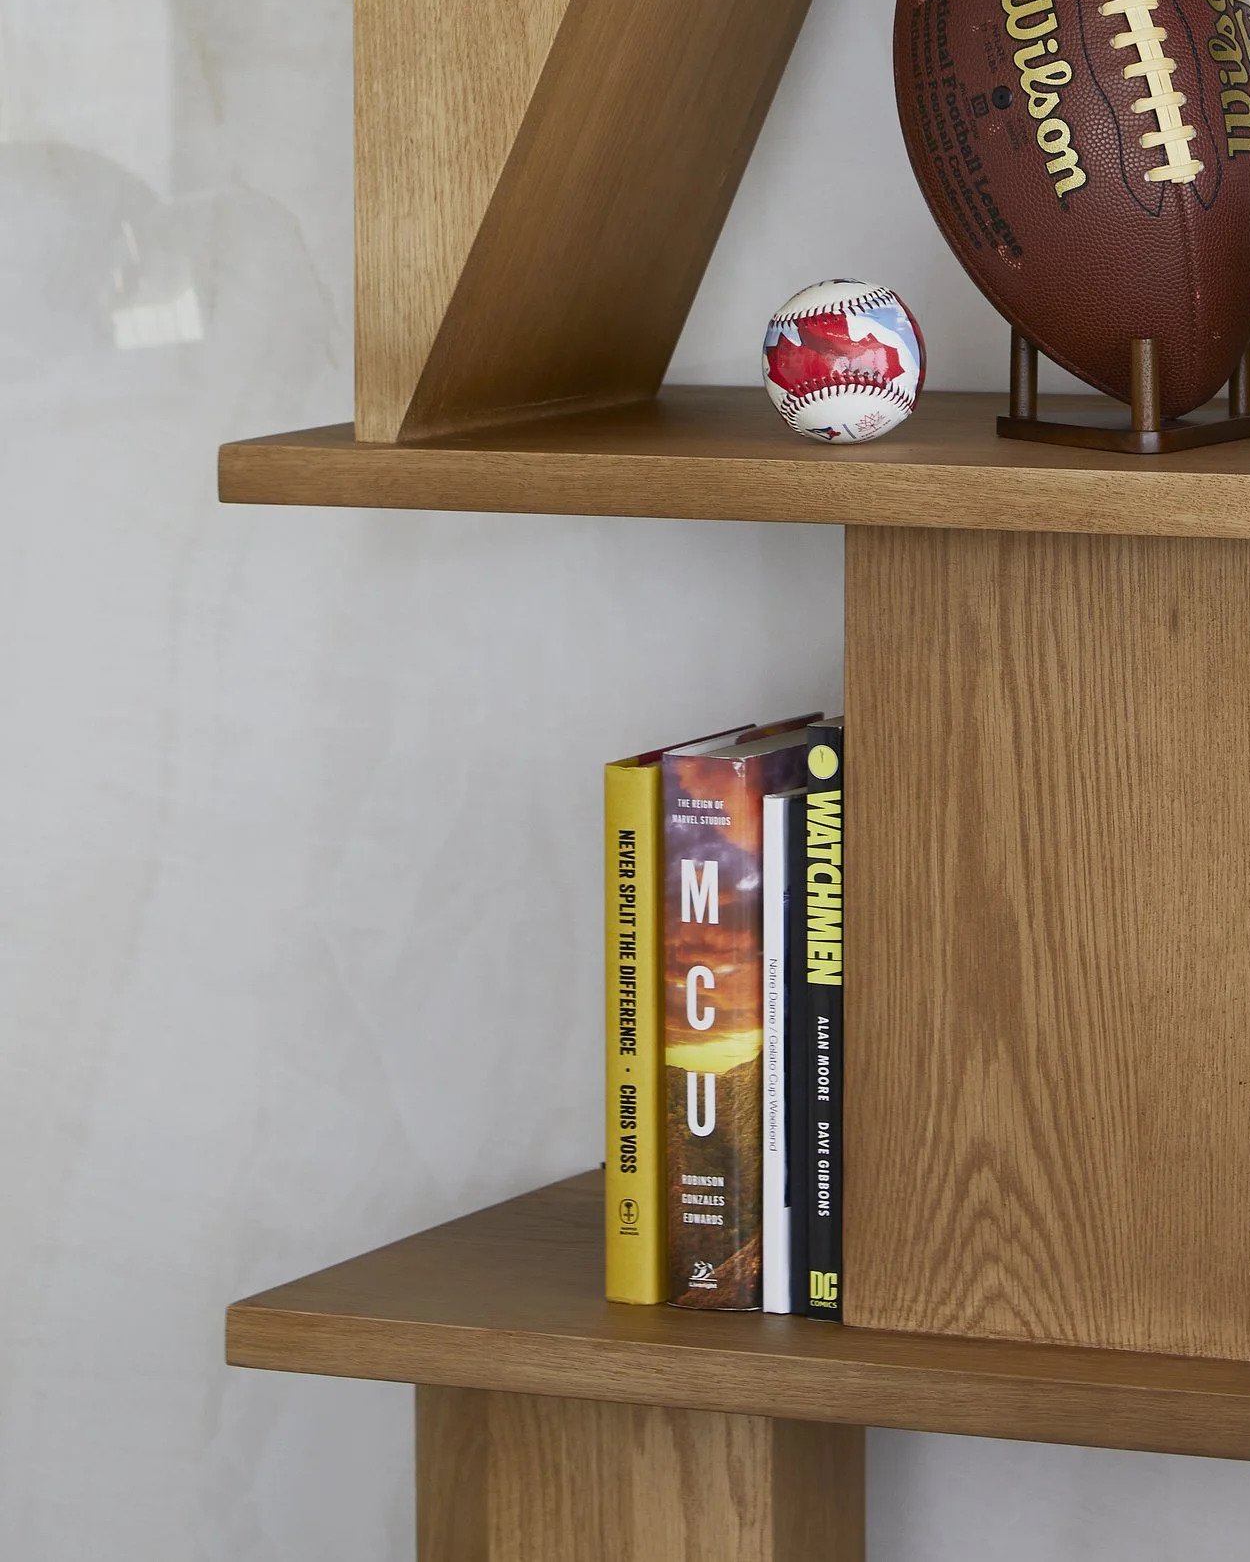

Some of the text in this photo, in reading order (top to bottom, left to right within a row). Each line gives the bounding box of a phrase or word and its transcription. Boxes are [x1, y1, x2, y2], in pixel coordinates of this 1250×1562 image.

[911, 5, 982, 249] National Football Conference
[929, 77, 954, 152] Football
[950, 155, 1000, 250] Conference
[942, 74, 983, 174] Football
[974, 176, 1023, 256] League
[677, 798, 724, 809] THE REIGN OF
[672, 814, 731, 826] MARVEL STUDIOS
[807, 790, 842, 986] WATCHMEN
[768, 958, 777, 989] Notre
[618, 830, 637, 1174] NEVER SPLIT THE DIFFERENCE CHRIS VOSS
[768, 992, 778, 1024] Dame
[768, 1036, 778, 1071] Gelato
[768, 1073, 778, 1097] Cup
[768, 1100, 778, 1152] Weekend
[817, 1016, 830, 1217] ALAN MOORE DAVE GIBBONS
[682, 1174, 724, 1187] ROBINSON
[681, 1193, 725, 1206] GONZALES
[683, 1213, 723, 1226] EDWARDS
[810, 1270, 838, 1301] DC
[810, 1300, 838, 1309] COMICS
